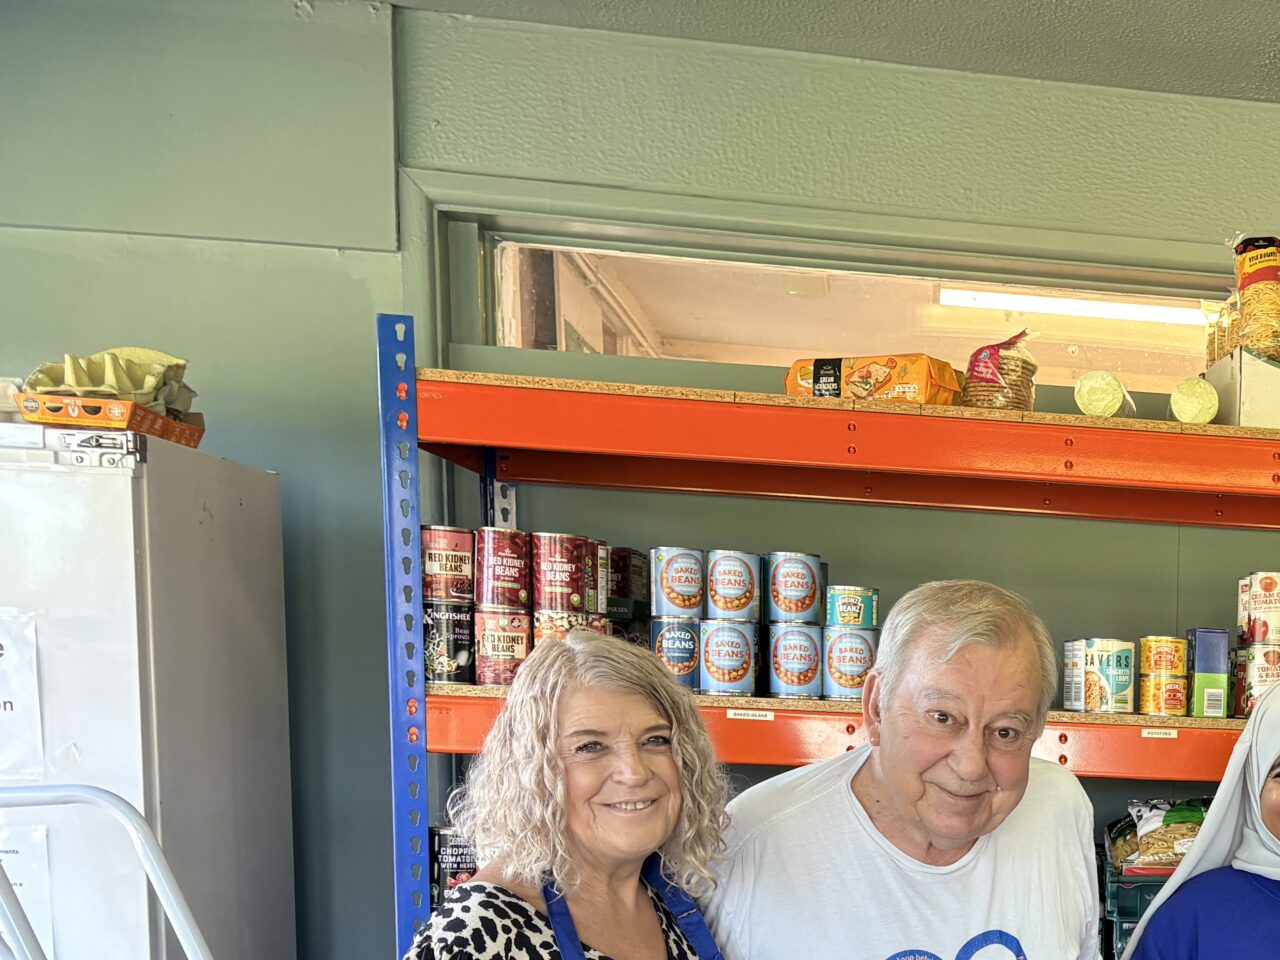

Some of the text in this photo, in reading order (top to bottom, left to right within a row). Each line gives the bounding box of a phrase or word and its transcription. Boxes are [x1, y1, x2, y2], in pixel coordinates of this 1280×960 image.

[428, 552, 470, 565] RED KIDNEY
[503, 558, 524, 568] KIDNEY
[440, 564, 463, 573] BEANS
[495, 567, 519, 577] BEANS
[553, 563, 576, 572] KIDNEY
[674, 567, 698, 576] BAKED
[546, 571, 570, 581] BEANS
[671, 576, 701, 584] BEANS
[716, 578, 746, 587] BEANS
[780, 580, 810, 589] BEANS
[423, 608, 471, 624] KINGFISHER
[482, 634, 524, 644] RED KIDNEY
[666, 631, 691, 640] BAKED
[491, 643, 515, 653] BEANS
[662, 640, 694, 649] BEANS
[712, 650, 744, 658] BEANS
[782, 652, 812, 661] BEANS
[837, 655, 868, 664] BEANS
[1085, 654, 1129, 668] SAVERS
